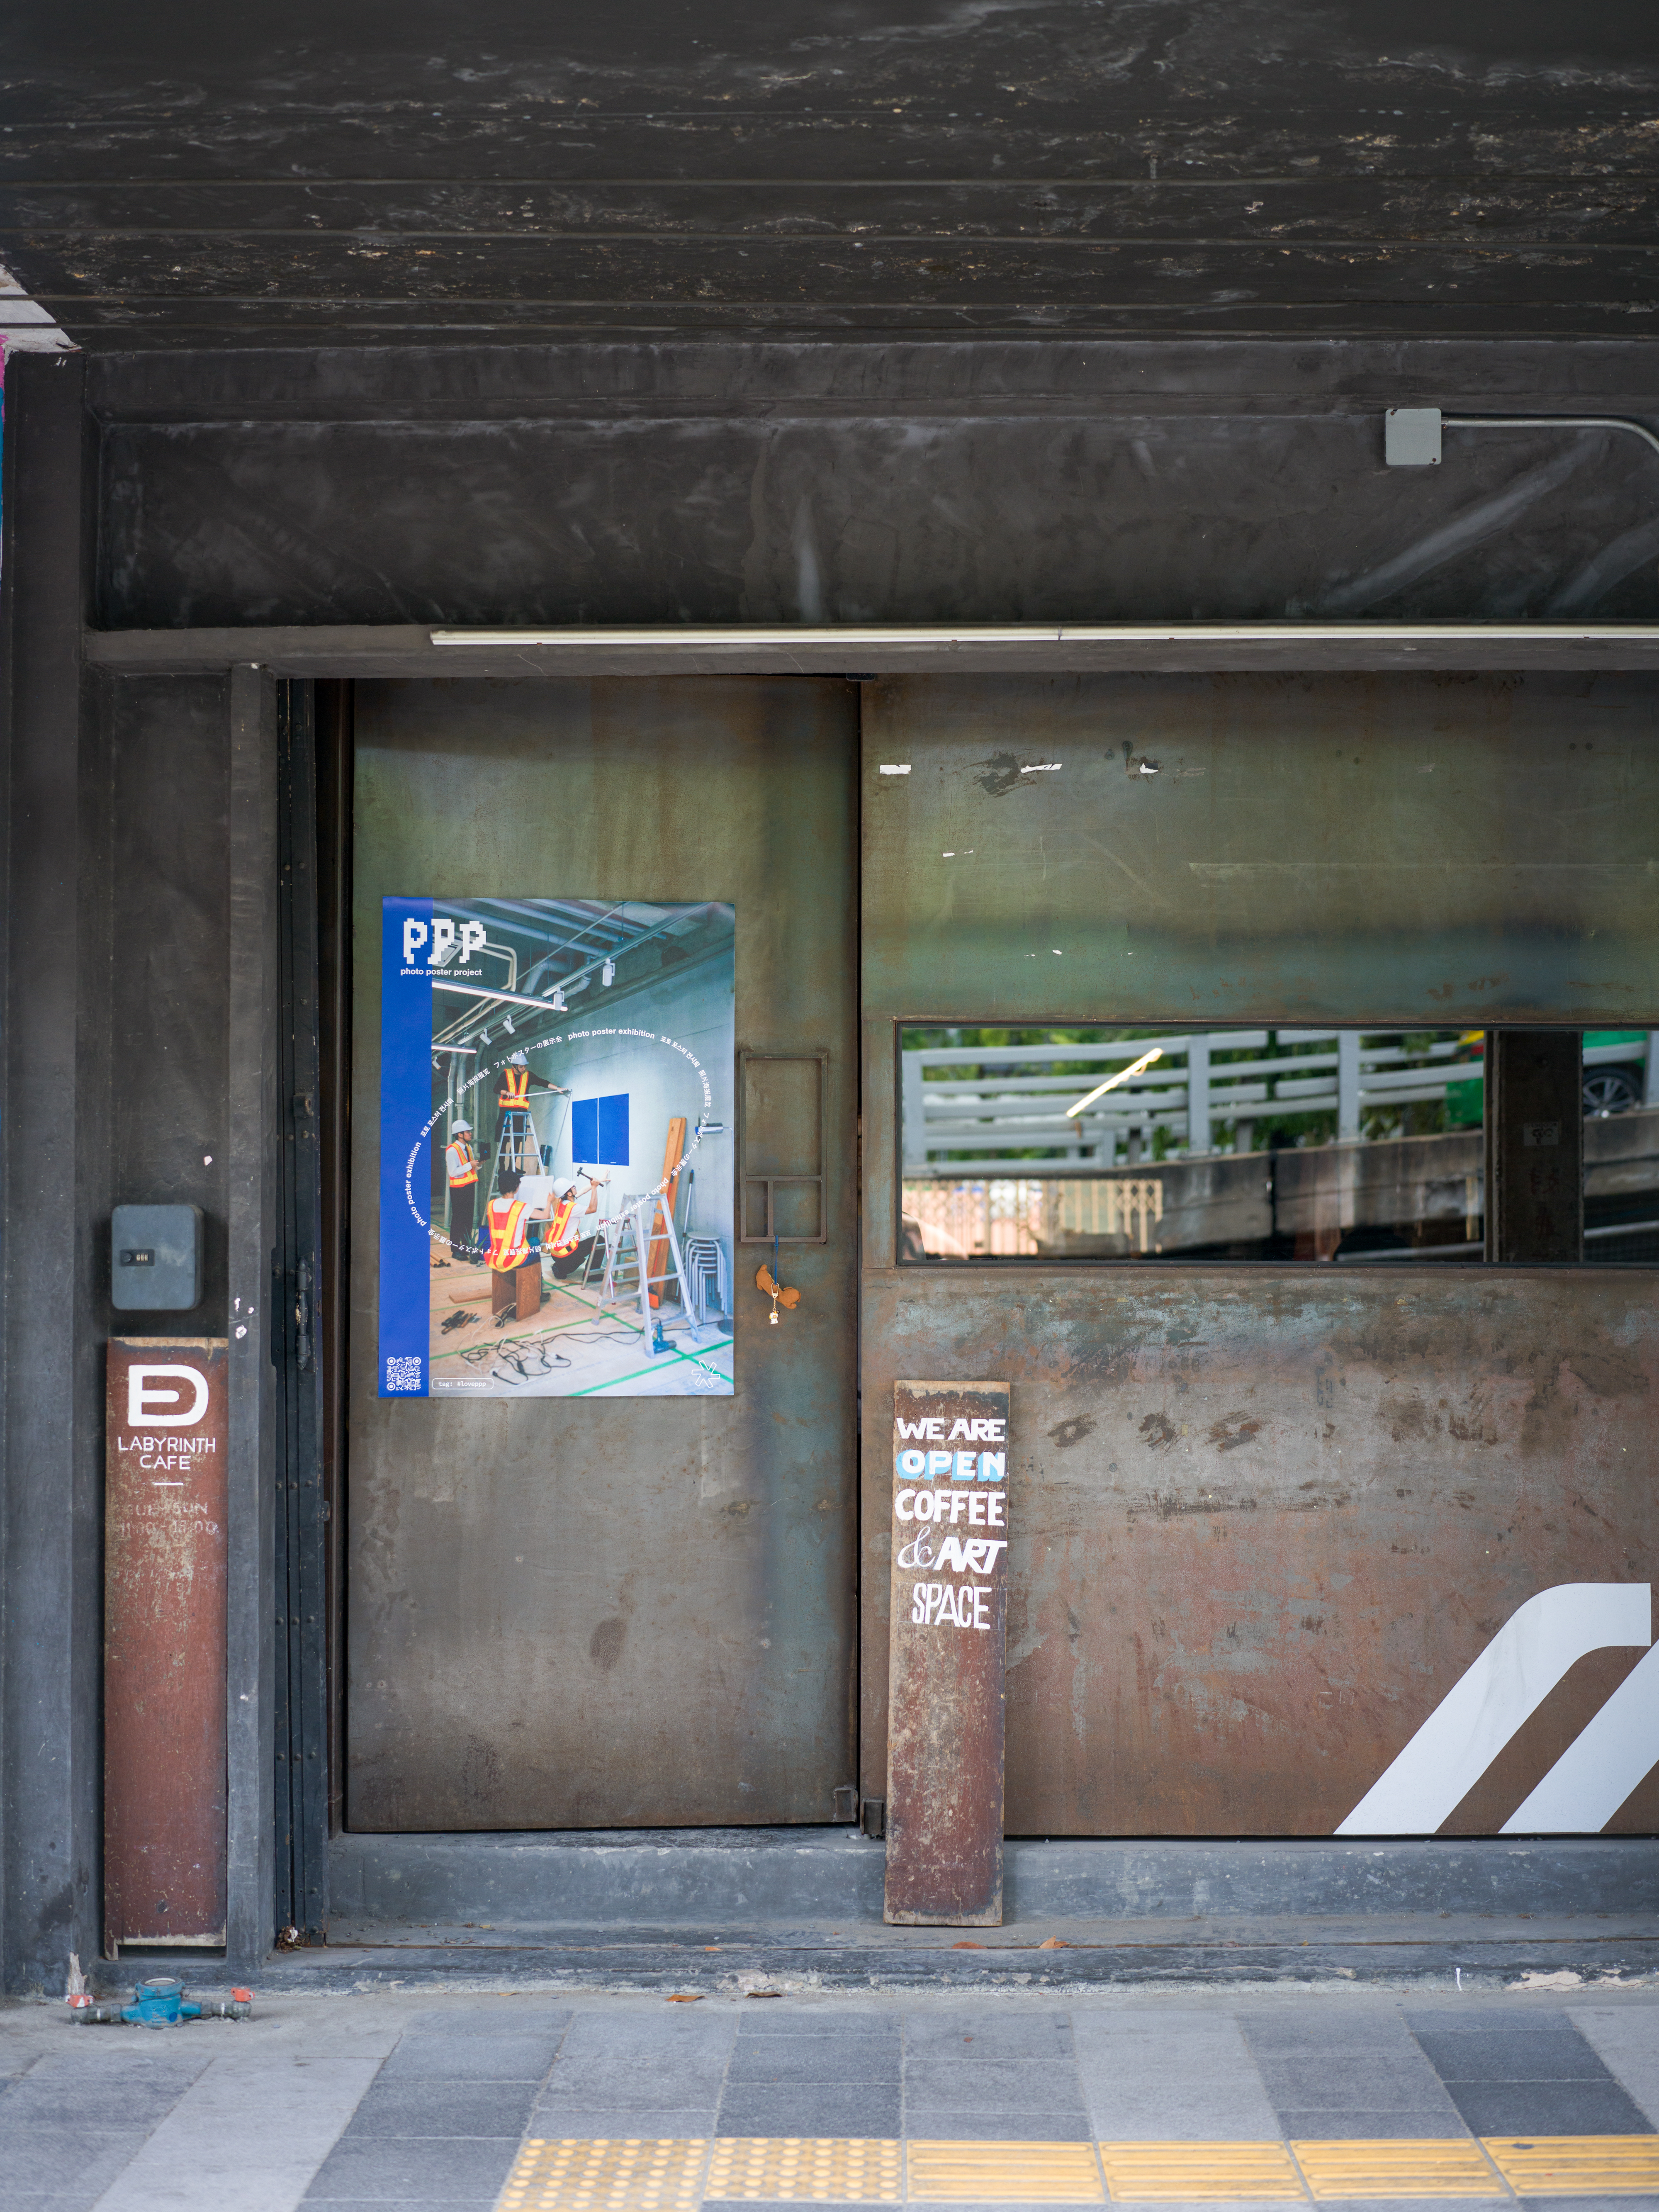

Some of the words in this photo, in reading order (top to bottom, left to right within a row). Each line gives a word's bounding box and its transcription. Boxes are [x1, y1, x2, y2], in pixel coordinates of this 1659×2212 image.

[568, 1030, 590, 1040] photo
[592, 1028, 616, 1036] poster
[618, 1029, 655, 1039] exhibition
[494, 1036, 562, 1068] フォトポスターの展示会
[660, 1036, 671, 1045] 포토
[671, 1042, 688, 1055] 포스터
[687, 1052, 700, 1068] 전시회
[457, 1068, 491, 1095] 照片海报展览
[698, 1069, 711, 1108] 照片海报展览
[420, 1127, 431, 1137] 포토
[428, 1111, 442, 1127] 포스터
[439, 1097, 454, 1112] 전시회
[406, 1141, 422, 1178] exhibition
[405, 1180, 415, 1205] poster
[651, 1177, 669, 1195] photo
[411, 1206, 427, 1226] photo
[630, 1193, 651, 1212] poster
[596, 1209, 630, 1231] exhibition
[896, 1417, 944, 1439] WE
[947, 1419, 1006, 1441] ARE
[117, 1436, 216, 1453] LABYRINTH
[140, 1455, 191, 1470] CAFE
[896, 1449, 1005, 1481] OPEN
[895, 1489, 1006, 1526] COFFEE
[933, 1536, 1007, 1574] ART
[912, 1582, 992, 1629] SPACE
